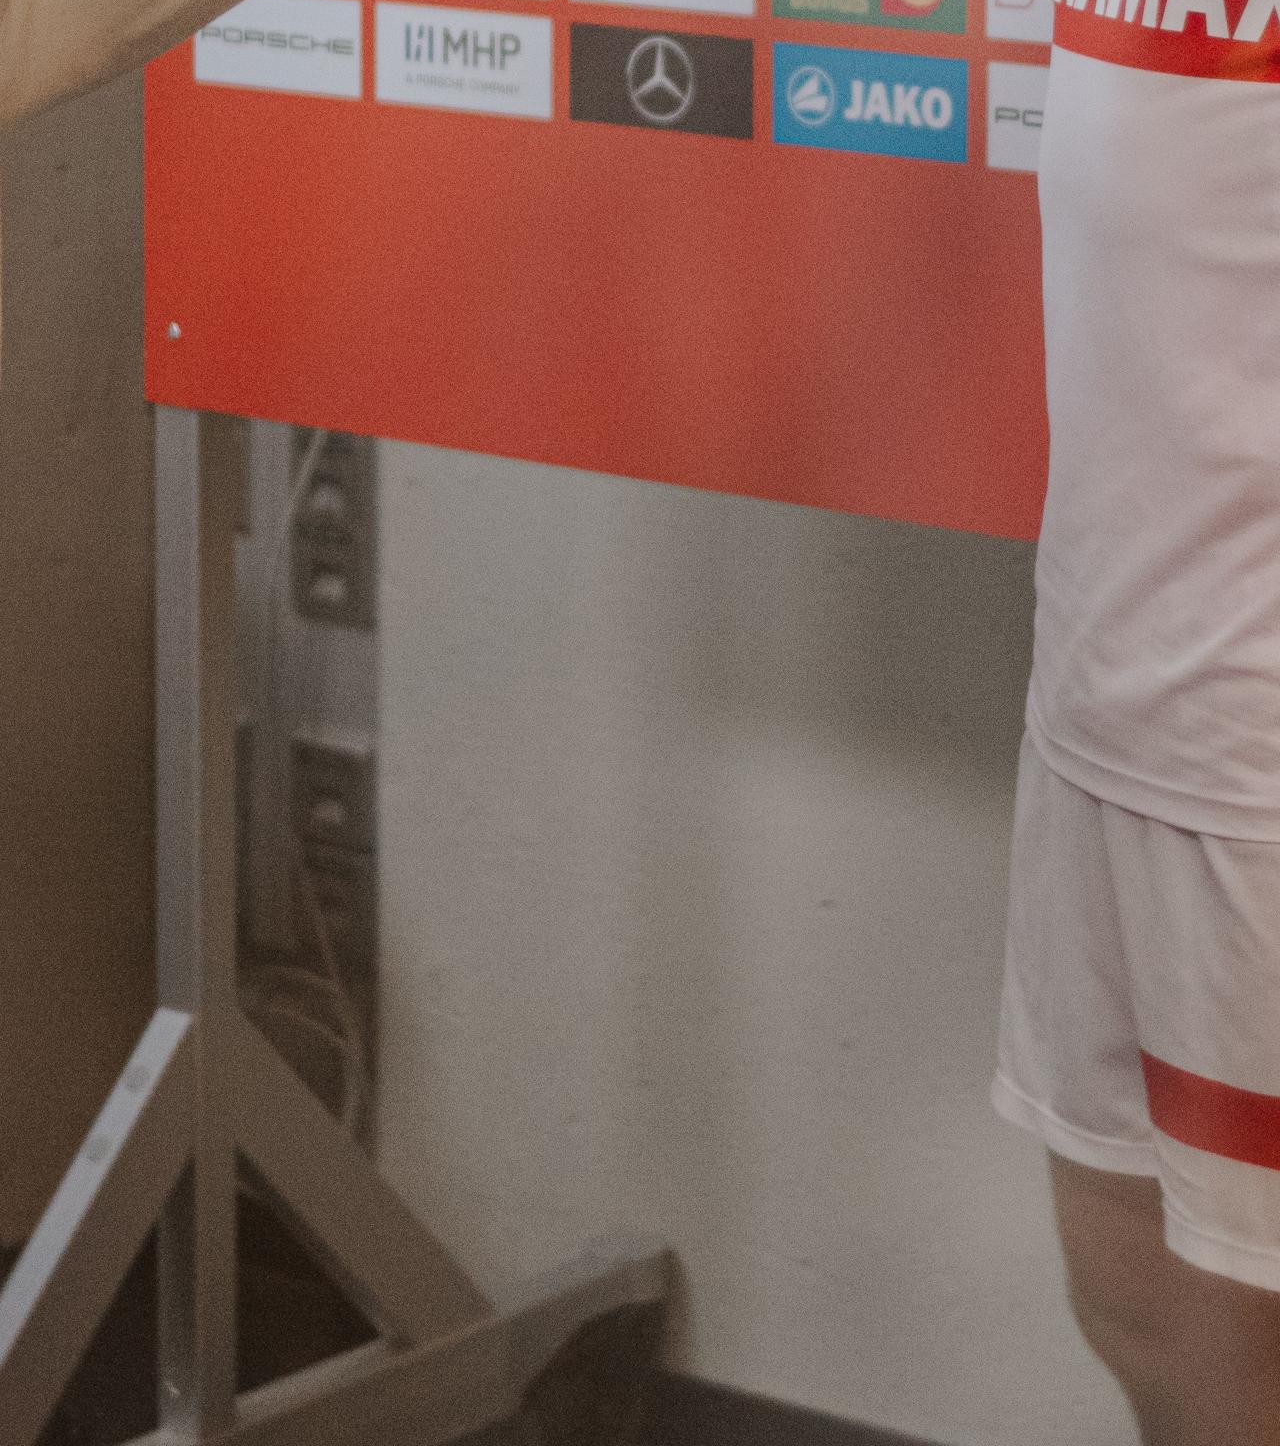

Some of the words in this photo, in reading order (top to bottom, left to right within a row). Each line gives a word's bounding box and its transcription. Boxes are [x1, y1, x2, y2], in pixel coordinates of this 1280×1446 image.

[200, 27, 354, 55] PORSCHE
[443, 29, 520, 70] MHP
[846, 81, 952, 129] JAKO
